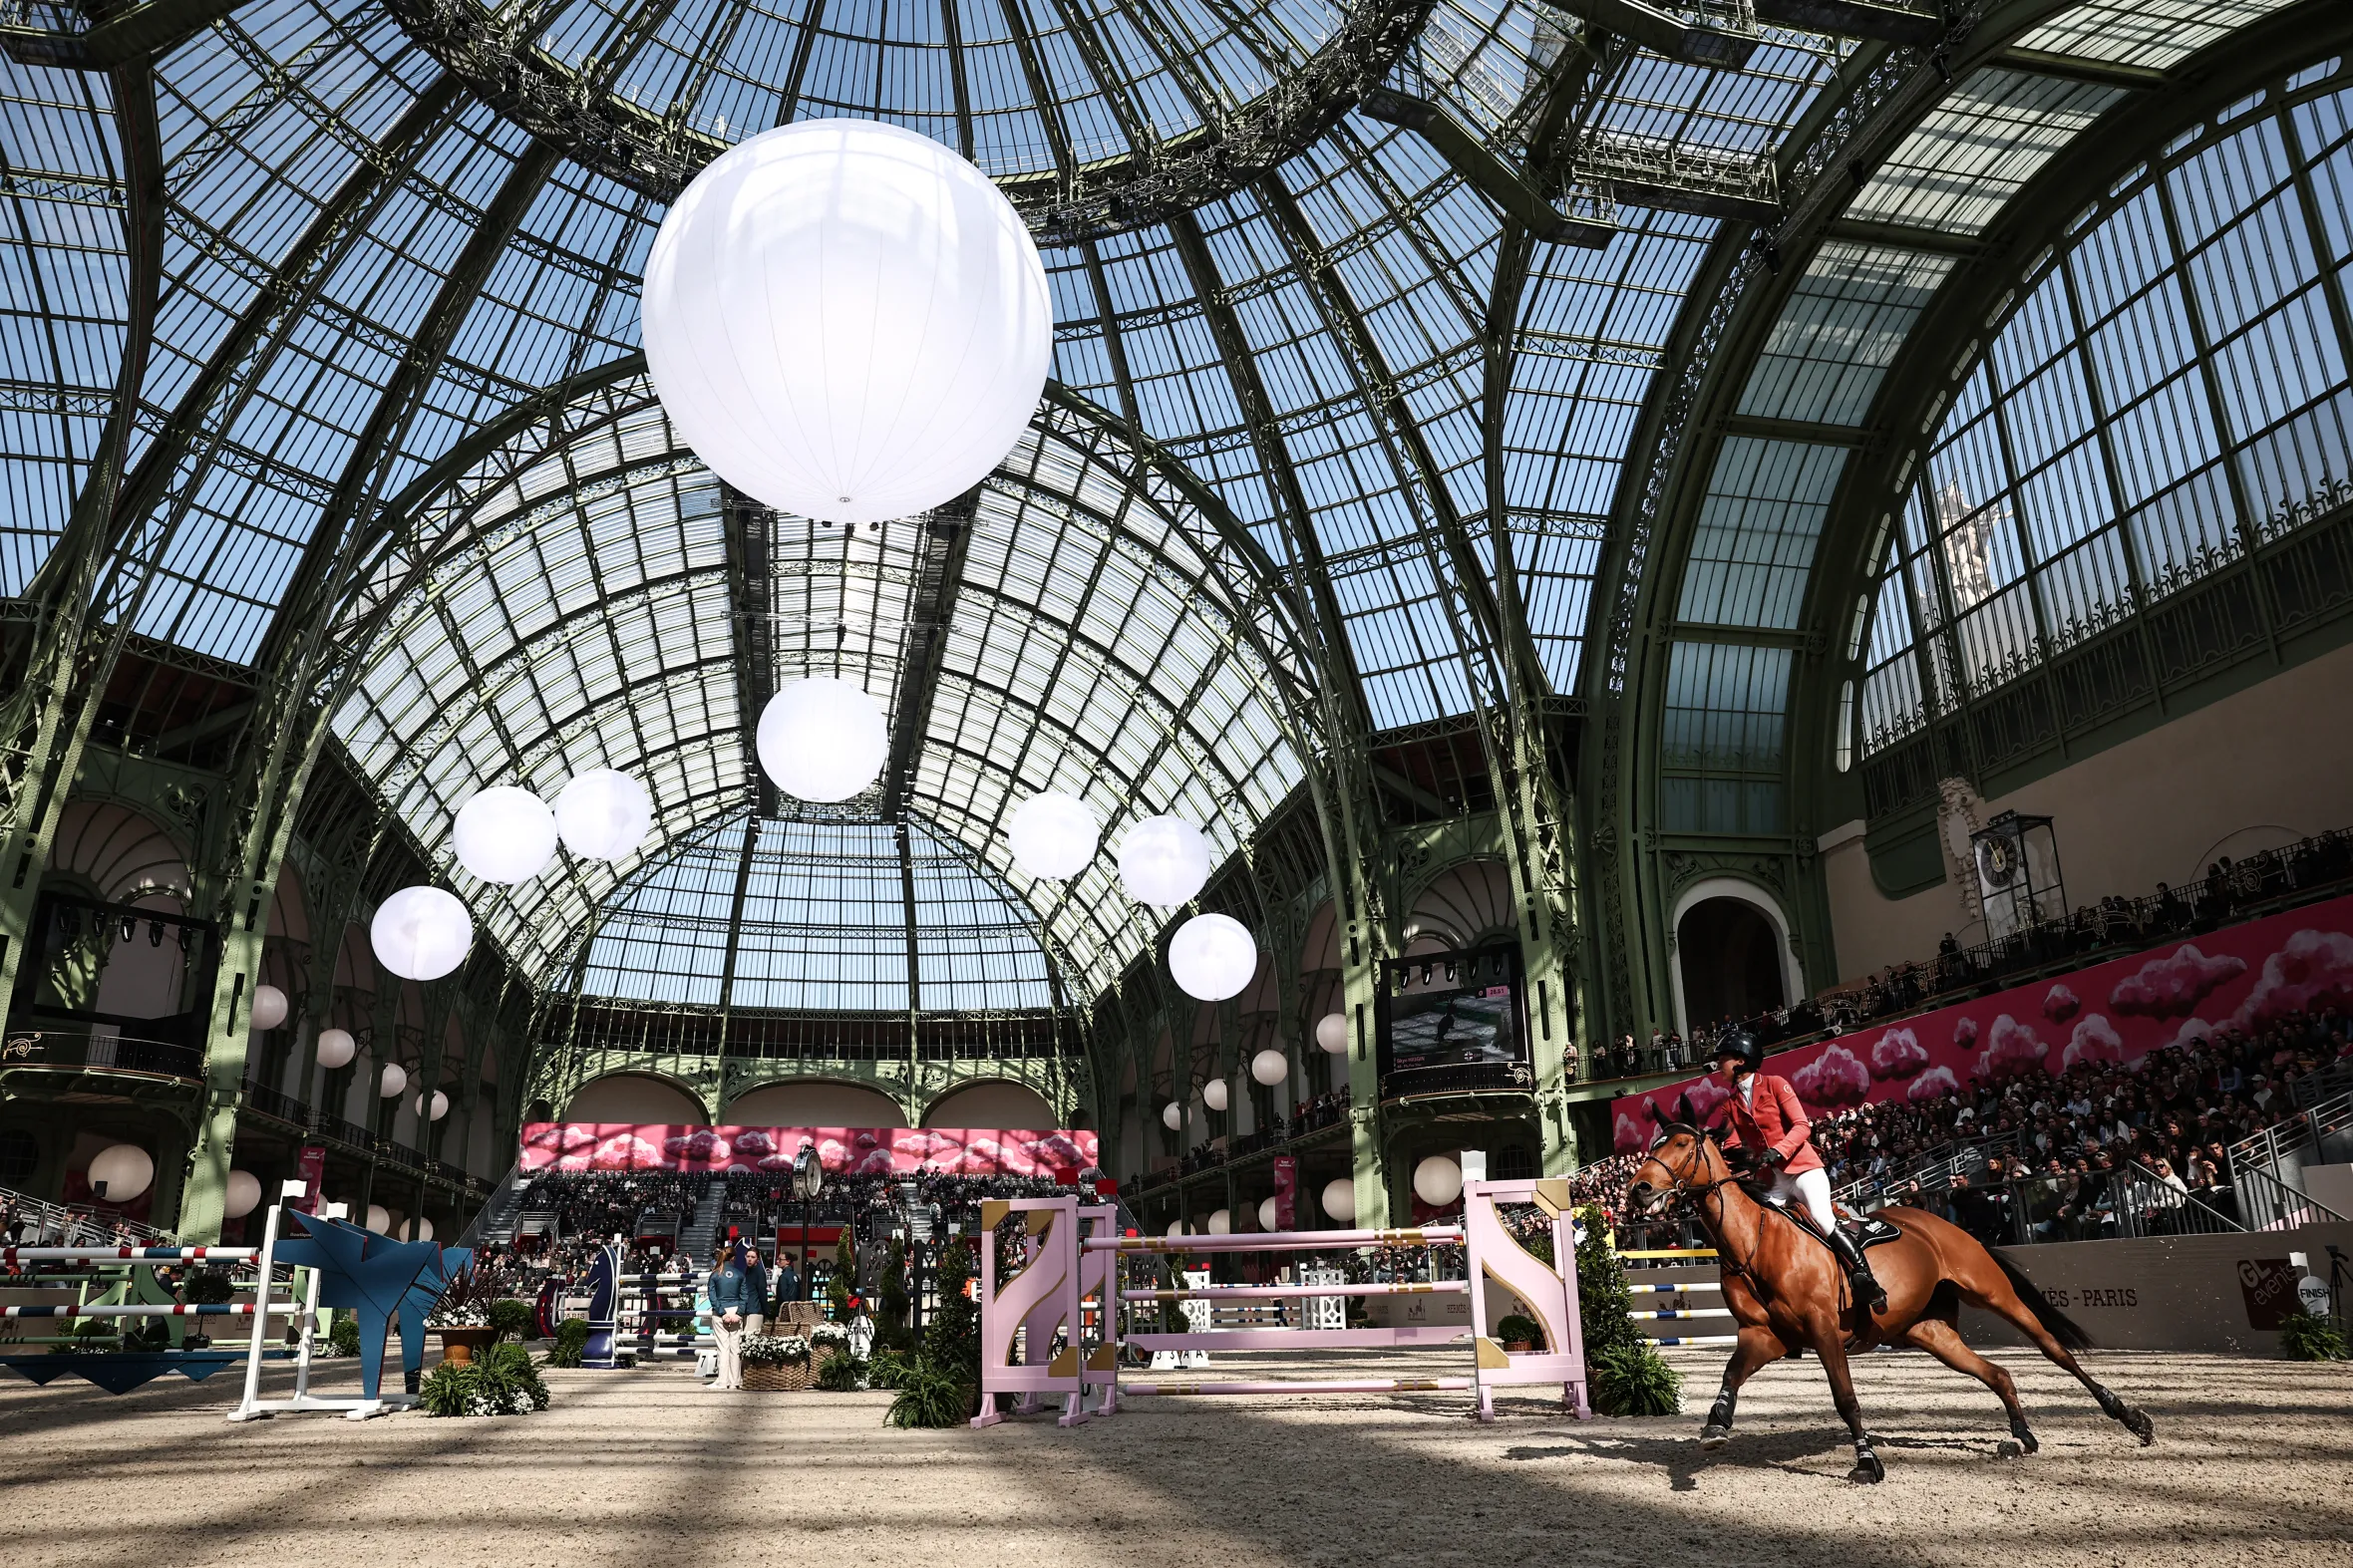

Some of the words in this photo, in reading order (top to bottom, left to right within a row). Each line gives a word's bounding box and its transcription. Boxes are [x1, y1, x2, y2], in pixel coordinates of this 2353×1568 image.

[2238, 1260, 2272, 1288] GL
[2254, 1263, 2297, 1306] events
[2299, 1289, 2330, 1298] FINISH
[2082, 1288, 2138, 1307] PARIS
[700, 1355, 707, 1369] 7
